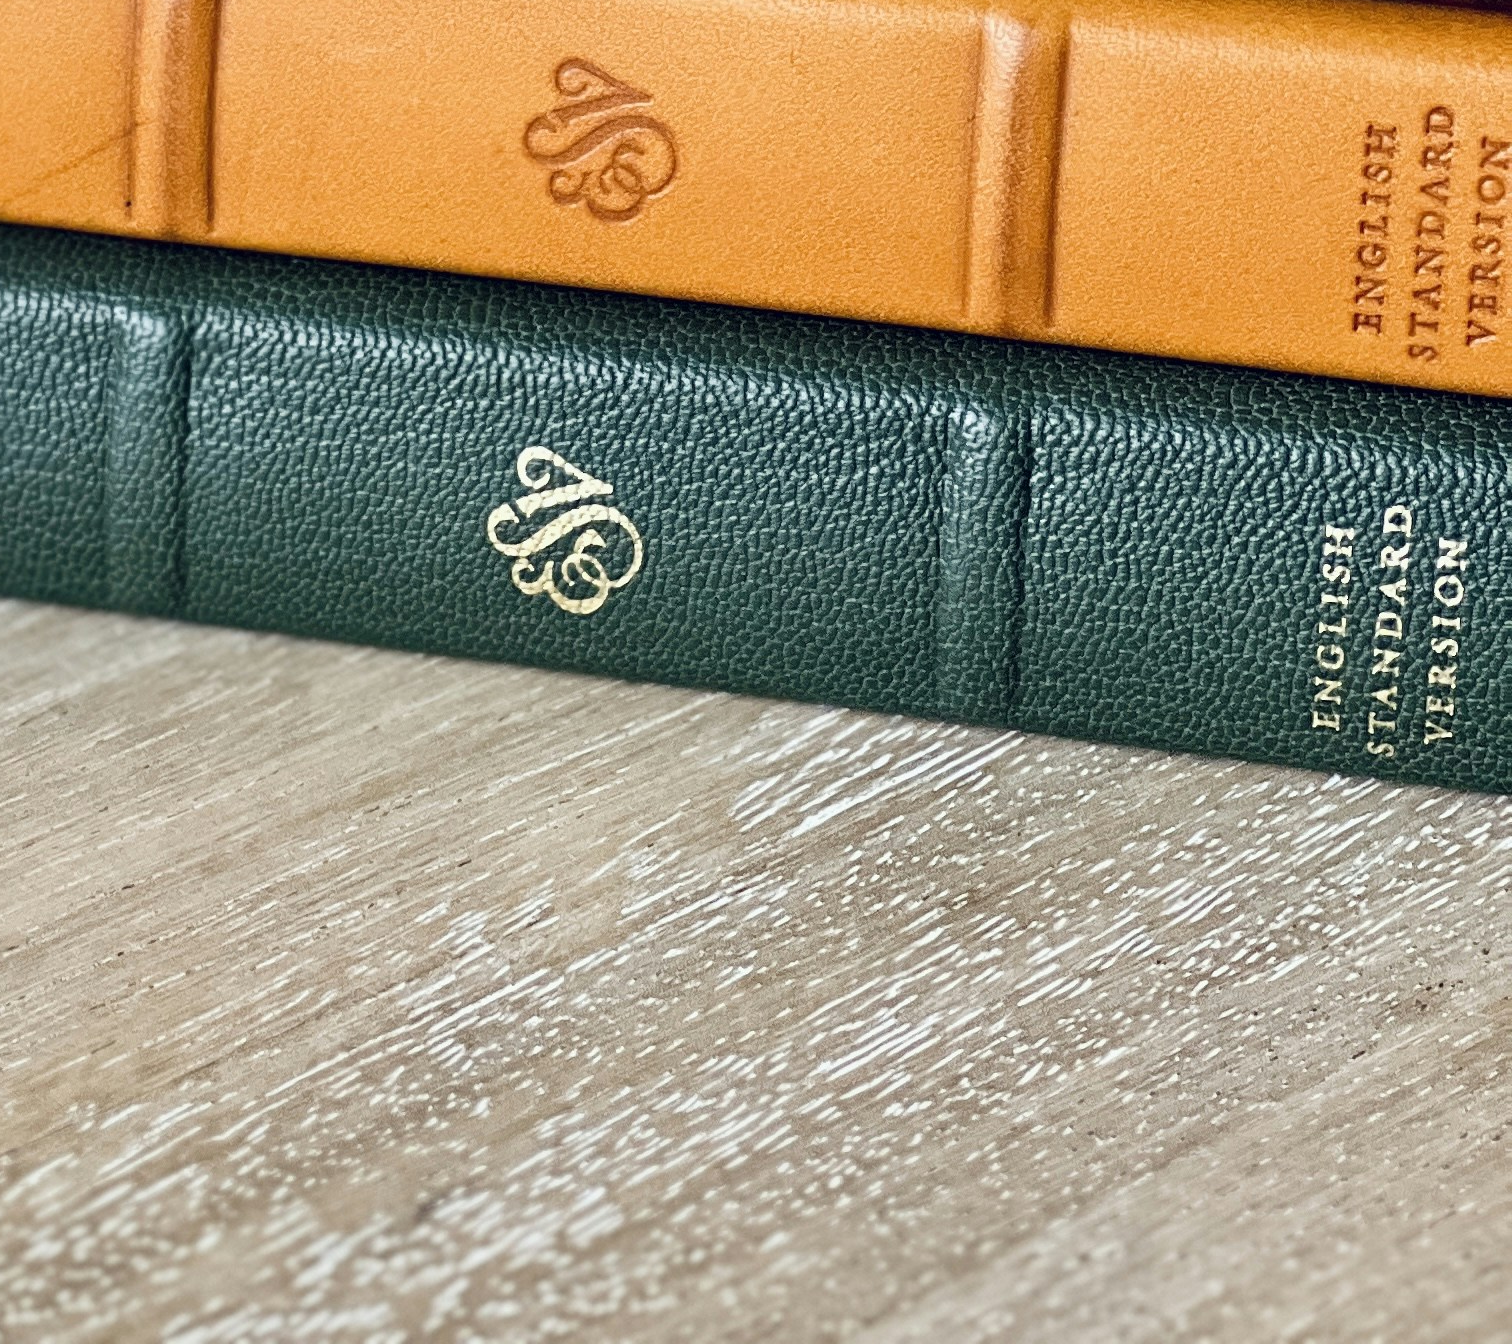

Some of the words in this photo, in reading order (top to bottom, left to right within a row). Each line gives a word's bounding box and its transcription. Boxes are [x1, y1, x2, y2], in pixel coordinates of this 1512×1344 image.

[1352, 123, 1397, 334] ENGLISH
[1407, 105, 1455, 362] STANDARD
[1465, 135, 1512, 347] VERSION
[1312, 524, 1355, 731] ENGLISH
[1366, 504, 1413, 758] STANDARD
[1423, 537, 1469, 744] VERSION
